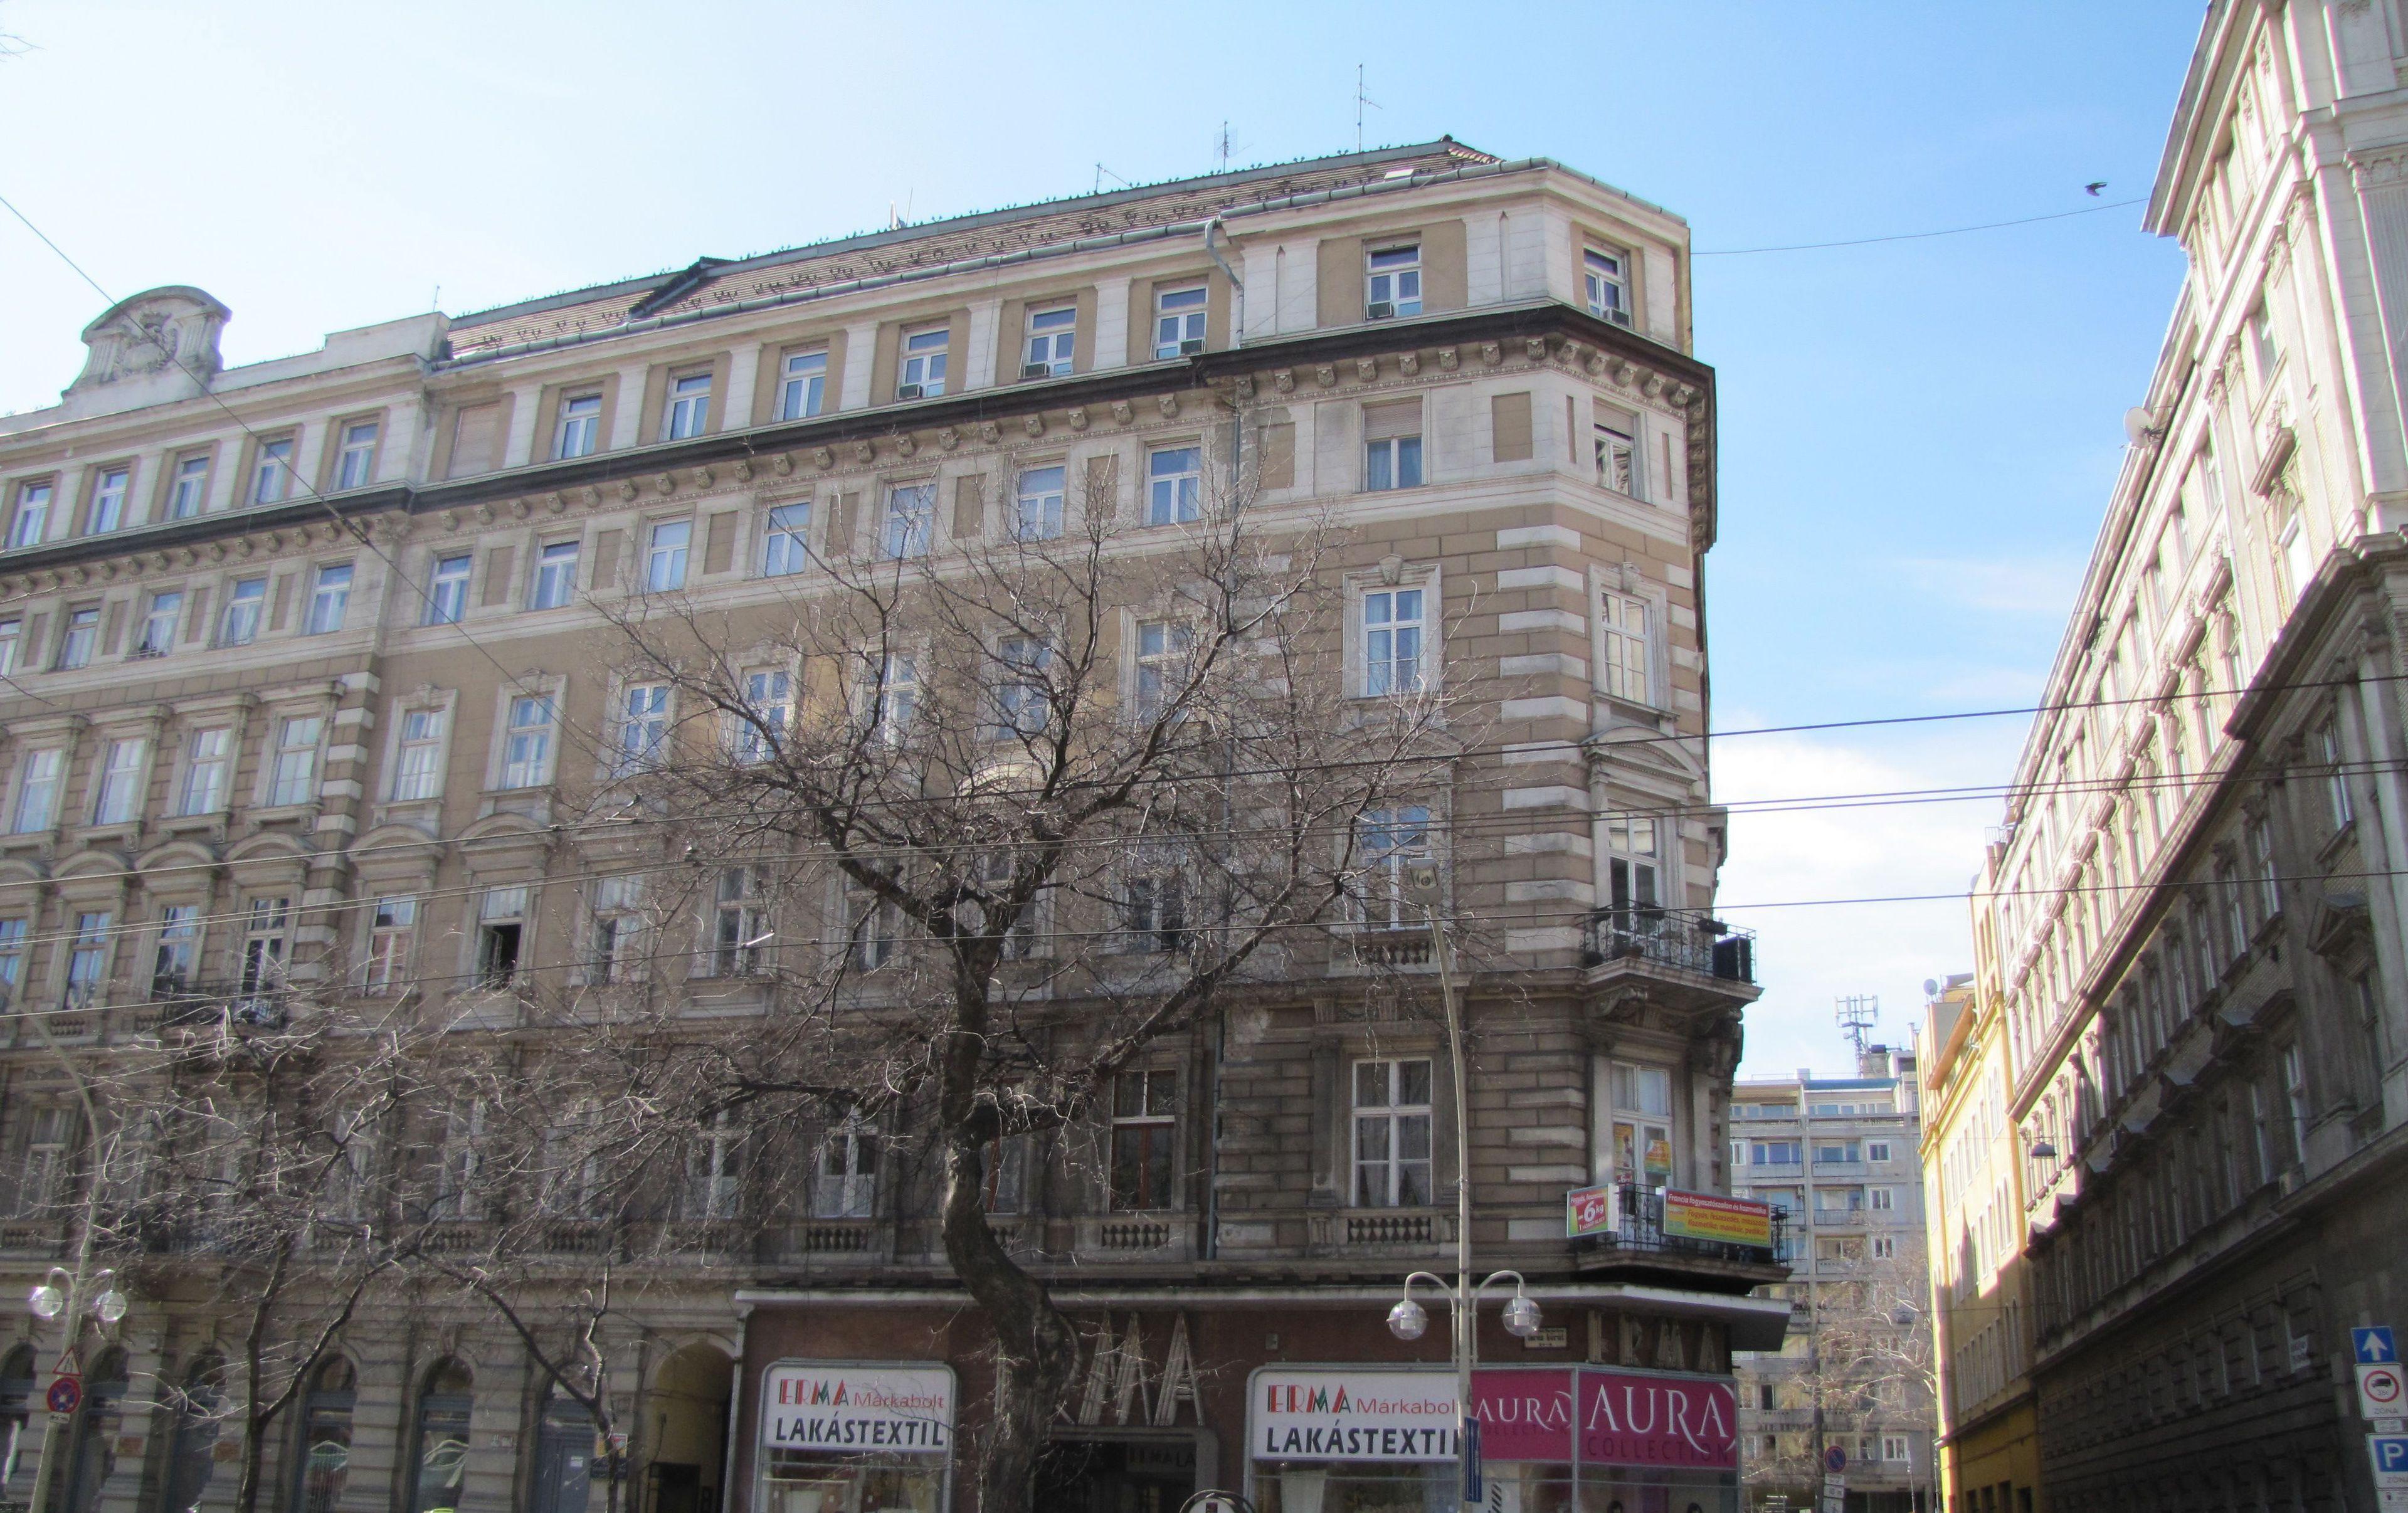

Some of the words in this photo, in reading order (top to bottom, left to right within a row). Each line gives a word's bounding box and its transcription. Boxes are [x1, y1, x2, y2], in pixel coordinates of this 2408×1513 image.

[1596, 1204, 1603, 1214] kg
[1669, 1193, 1689, 1203] Francia
[778, 1379, 849, 1406] ERMA
[854, 1391, 944, 1409] Márkabolt
[1267, 1384, 1351, 1414] ERMA
[1356, 1397, 1458, 1415] Márkabol
[776, 1410, 944, 1446] LAKÁSTEXTIL
[1476, 1398, 1568, 1431] AURA
[1585, 1383, 1729, 1455] AURA
[1587, 1437, 1729, 1462] COLLECTION
[2384, 1443, 2404, 1468] P
